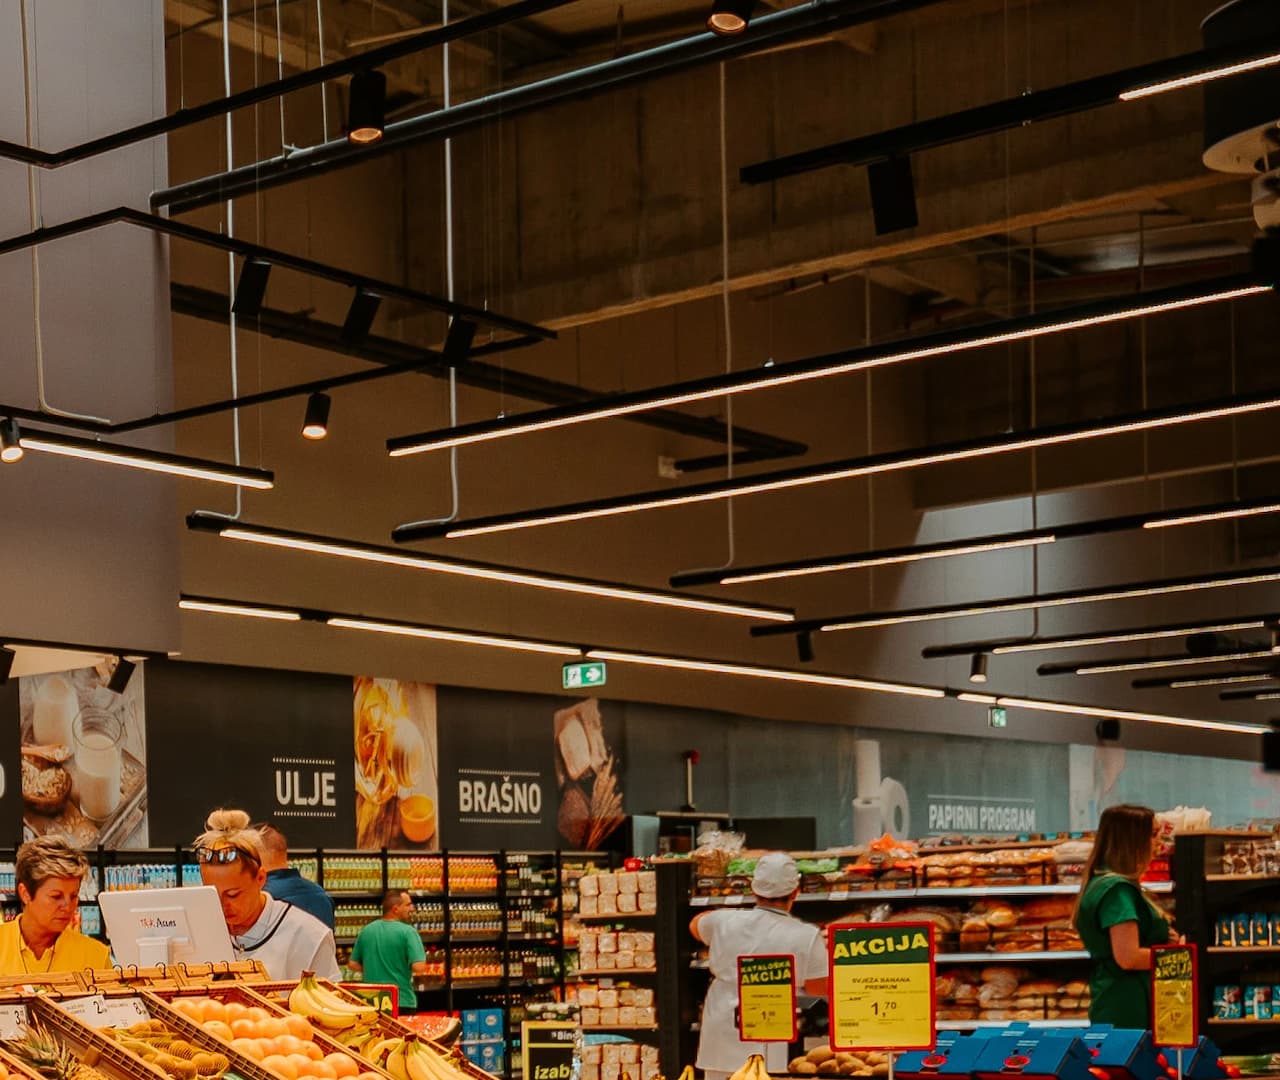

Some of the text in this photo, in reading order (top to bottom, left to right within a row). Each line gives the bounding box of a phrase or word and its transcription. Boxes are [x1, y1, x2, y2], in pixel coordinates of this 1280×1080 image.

[274, 769, 336, 807] ULJE
[458, 774, 542, 814] BRAŠNO
[928, 804, 1036, 832] PAPIRNI PROGRAM
[833, 933, 929, 959] AKCIJA
[741, 969, 792, 984] AKCIJA
[1155, 961, 1192, 978] AKCIJA
[93, 1000, 103, 1014] 2
[14, 1009, 21, 1025] 3
[534, 1064, 571, 1080] izab
